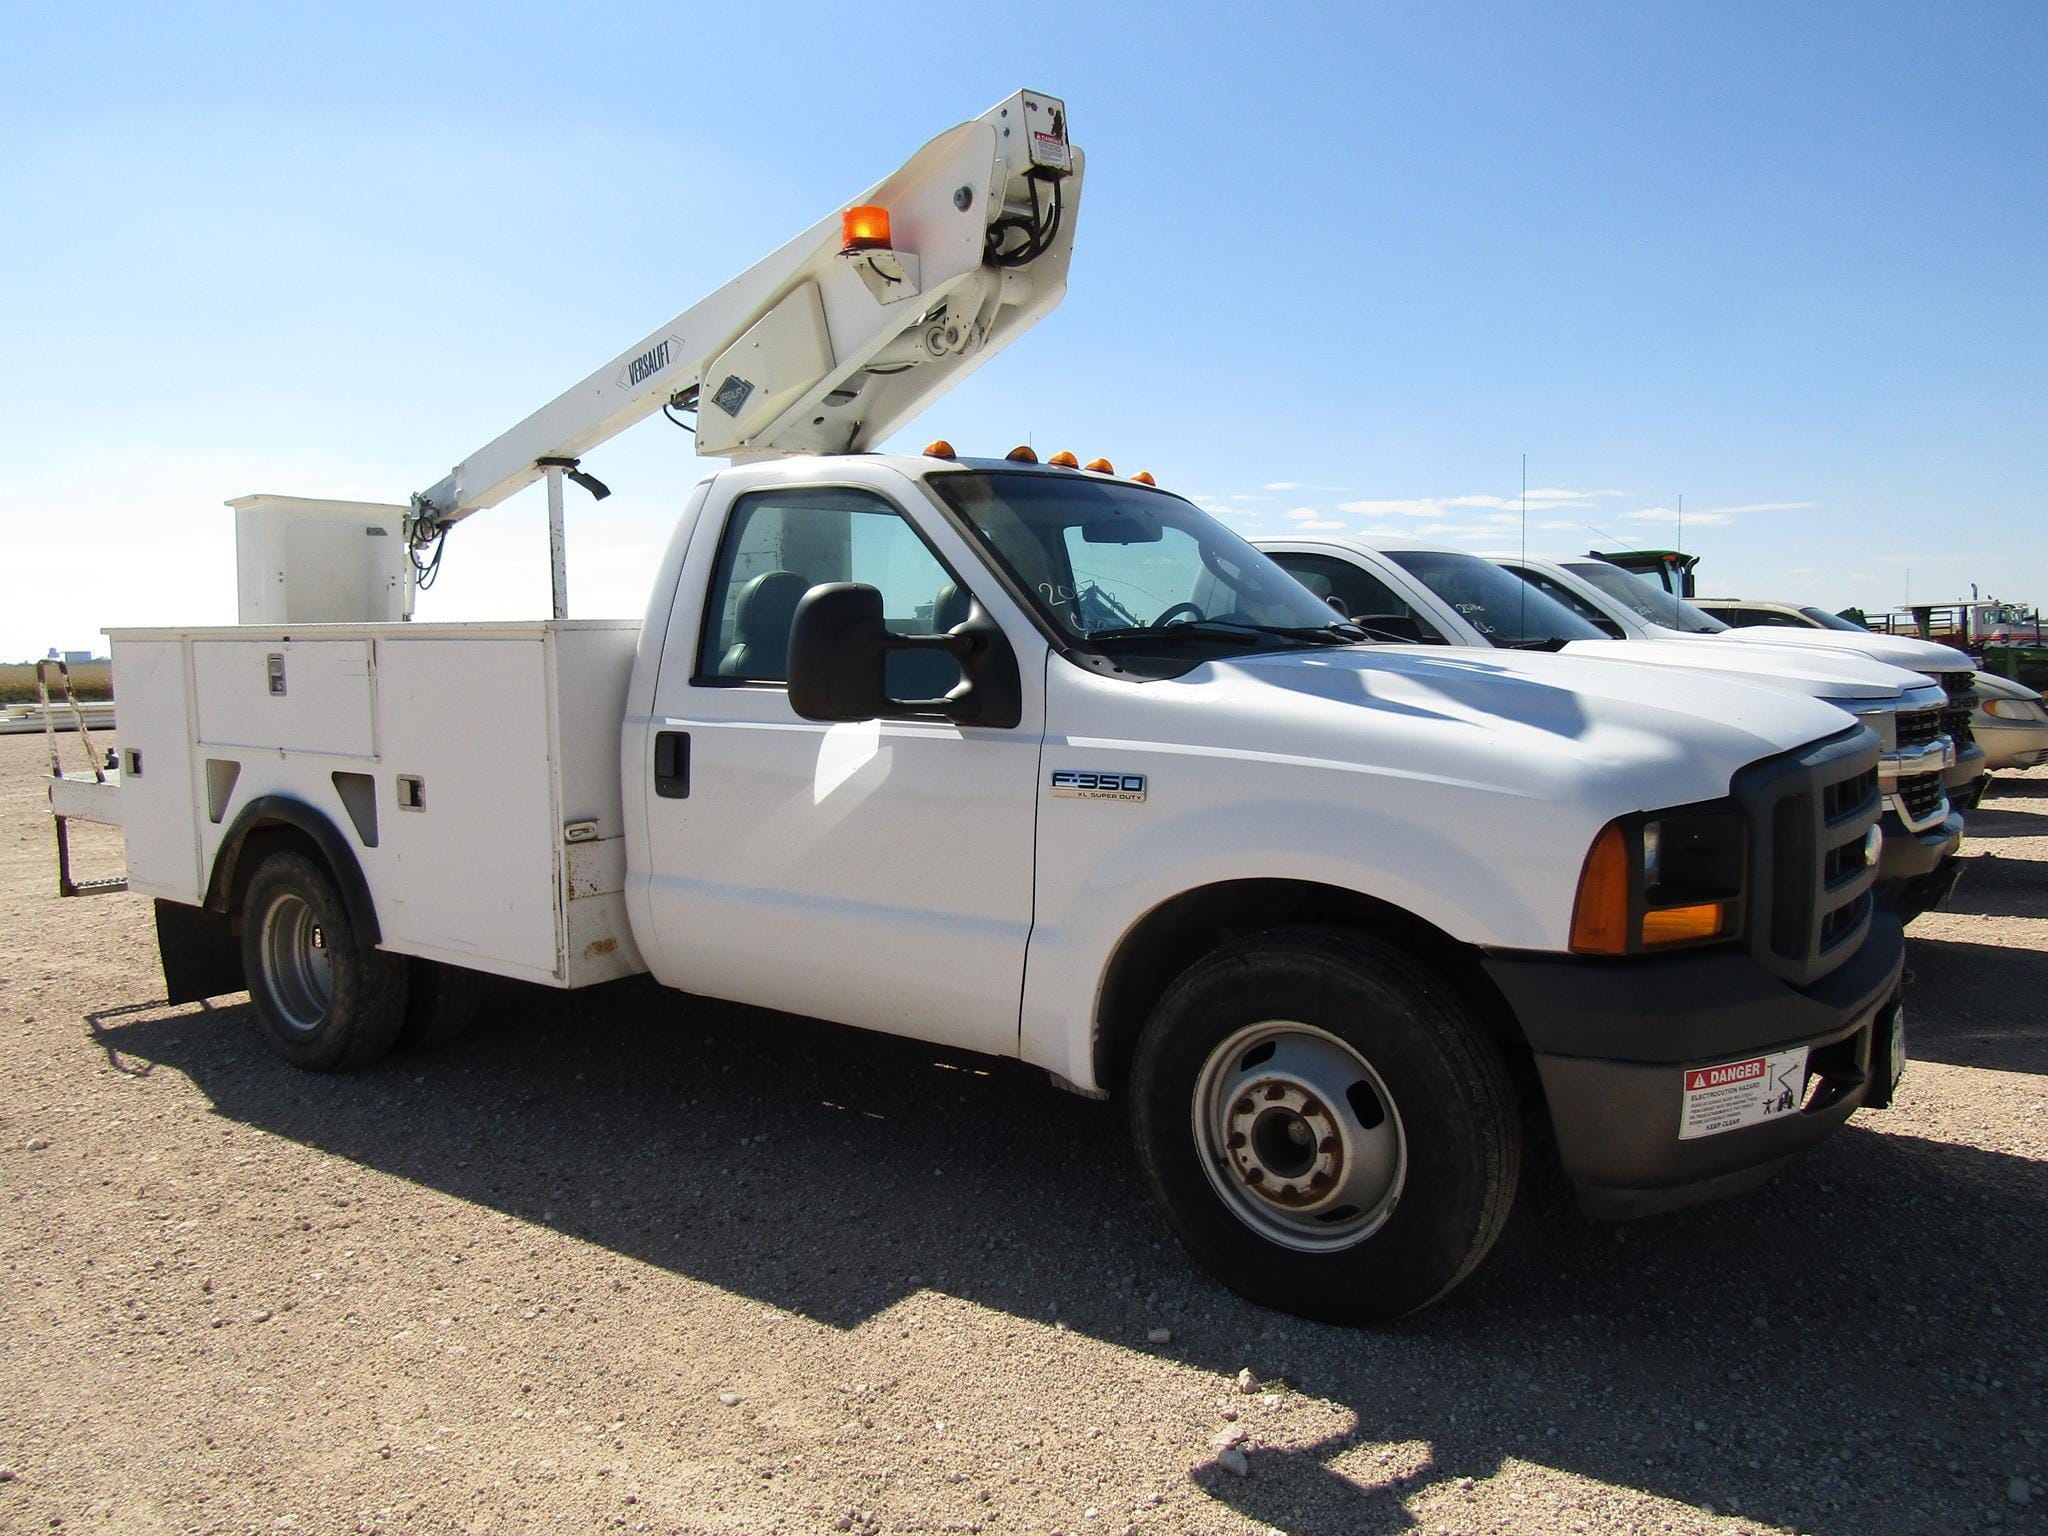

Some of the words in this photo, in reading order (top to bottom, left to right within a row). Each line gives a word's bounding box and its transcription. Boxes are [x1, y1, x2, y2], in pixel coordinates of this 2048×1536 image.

[628, 340, 670, 386] VERSALIFT
[1052, 772, 1144, 792] F-350
[1119, 793, 1142, 801] DUTY
[1710, 1062, 1761, 1085] DANGER
[1690, 1087, 1738, 1101] ELECTROCUTION
[1738, 1081, 1761, 1092] HAZARD
[1705, 1121, 1721, 1130] KEEP
[1721, 1118, 1741, 1128] CLEAR
